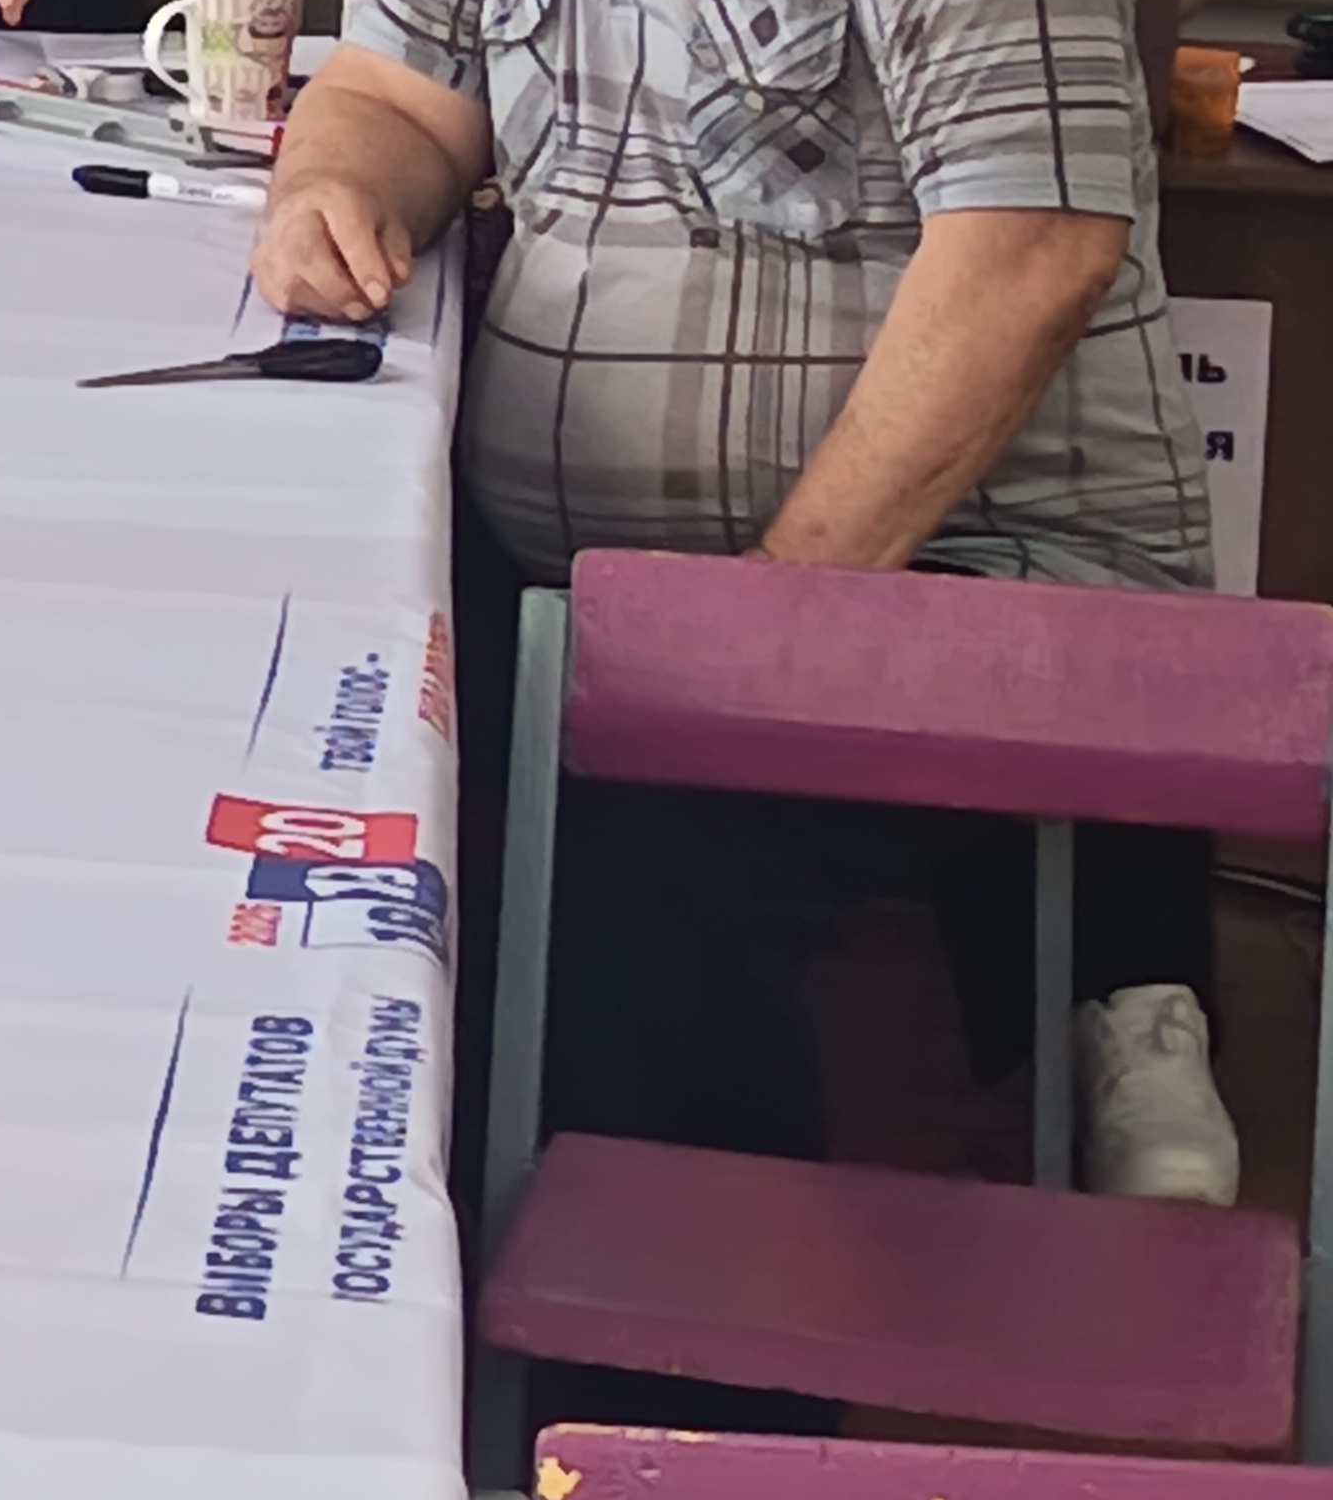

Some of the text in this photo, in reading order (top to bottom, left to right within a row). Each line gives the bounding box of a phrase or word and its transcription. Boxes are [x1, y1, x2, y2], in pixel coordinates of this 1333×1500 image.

[254, 809, 367, 860] 20
[194, 1014, 315, 1321] ВЫБОРЫ ДЕПУТАТОВ
